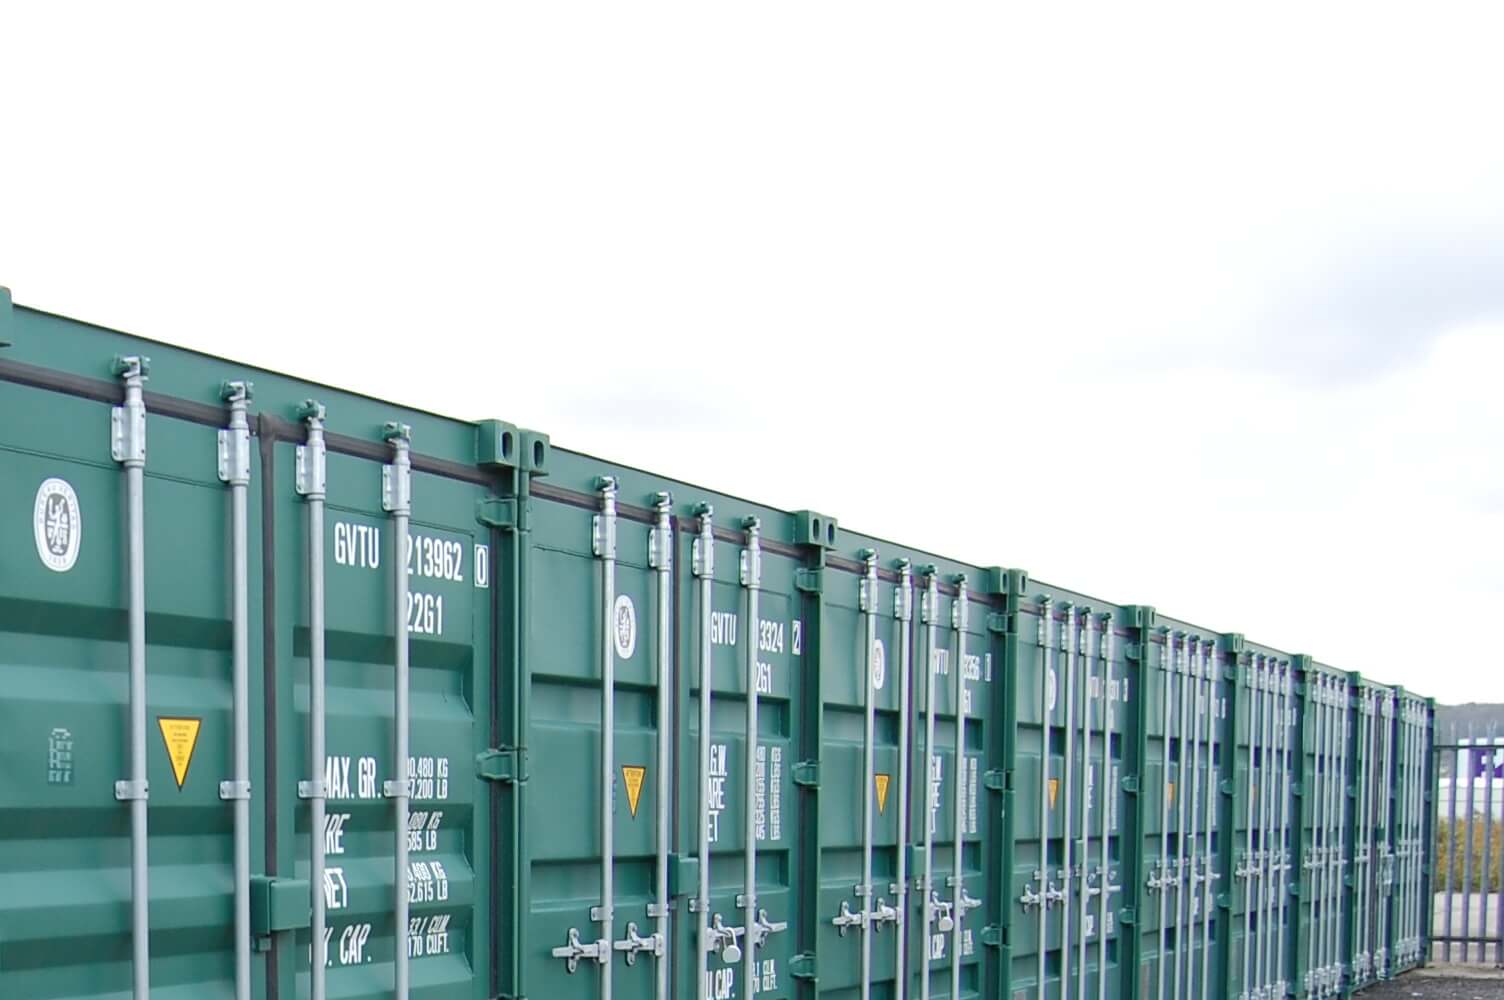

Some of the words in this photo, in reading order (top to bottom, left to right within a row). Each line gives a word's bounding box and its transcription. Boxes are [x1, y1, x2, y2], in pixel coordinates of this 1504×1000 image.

[334, 522, 380, 569] GVTU
[711, 611, 737, 645] GVTU
[358, 757, 381, 799] GR.
[437, 779, 448, 799] LB
[426, 830, 437, 851] LB
[339, 923, 372, 965] CAP.
